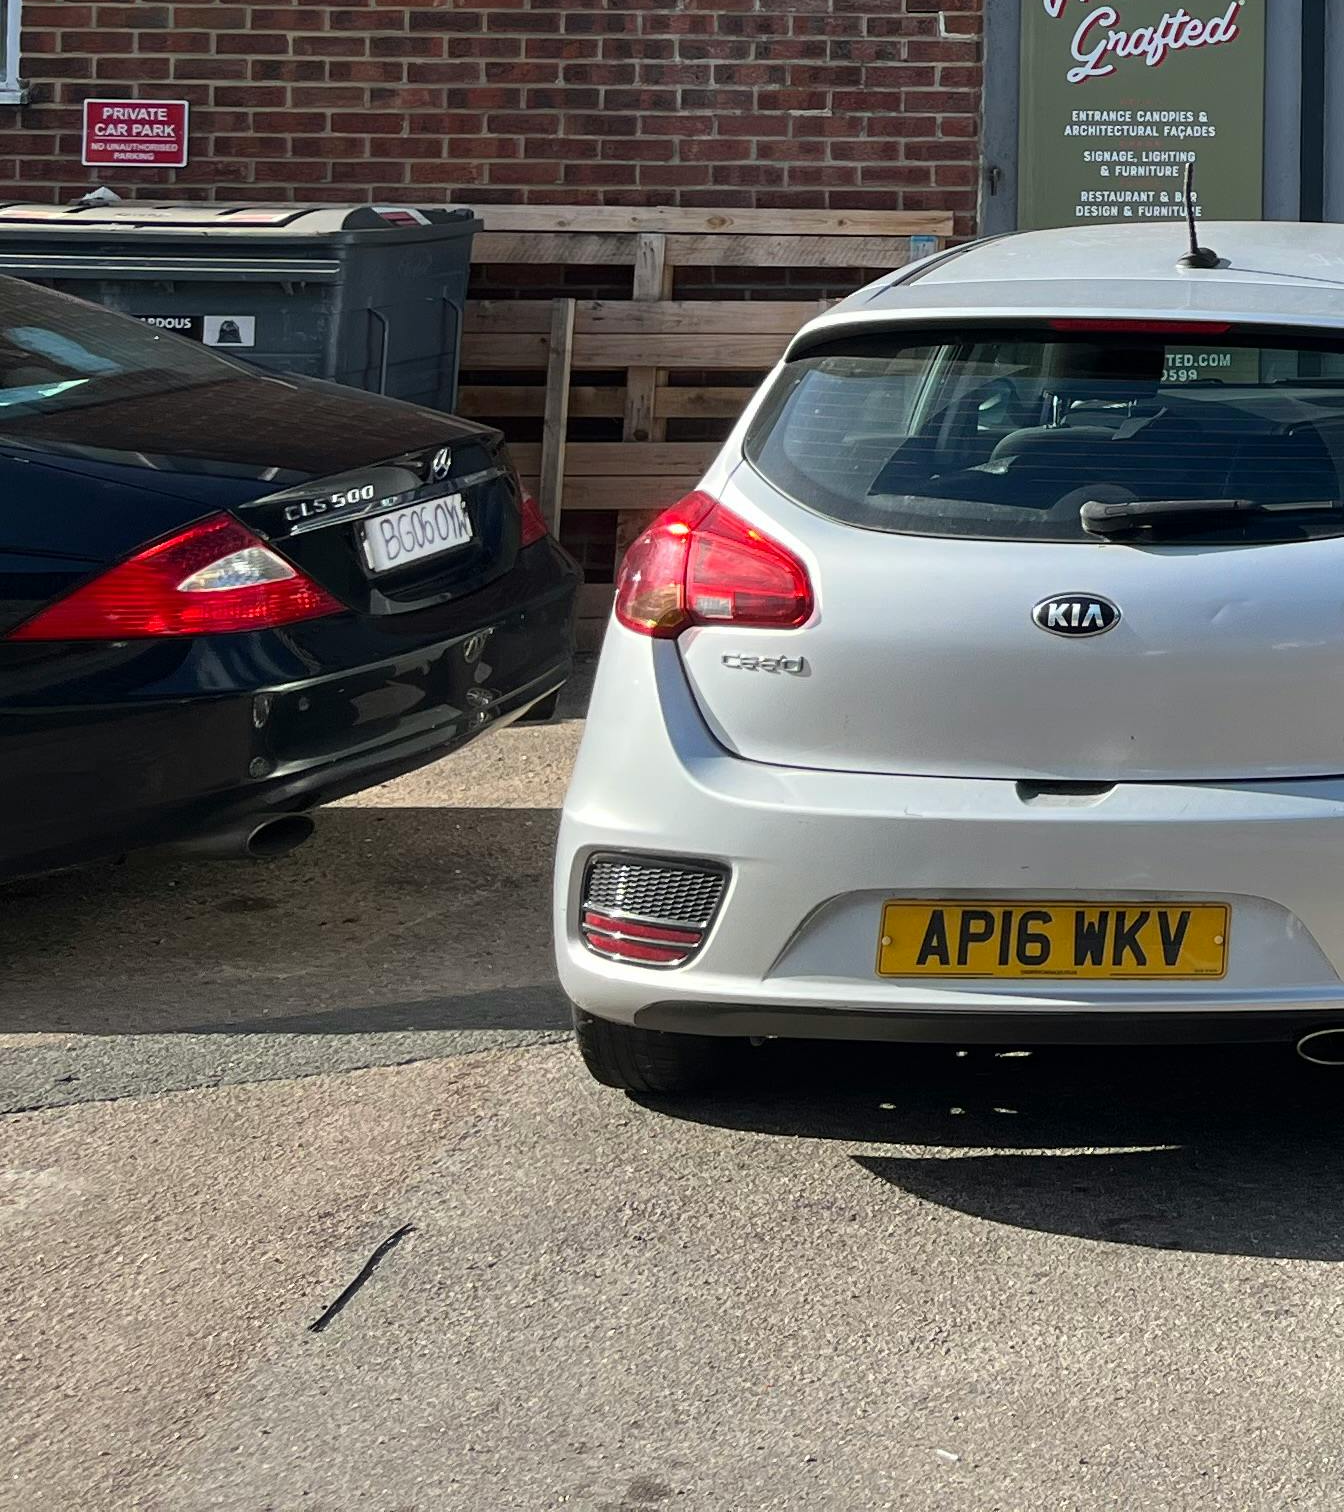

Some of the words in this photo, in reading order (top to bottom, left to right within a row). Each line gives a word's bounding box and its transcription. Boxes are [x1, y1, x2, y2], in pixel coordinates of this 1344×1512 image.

[1066, 1, 1241, 84] Grafted
[102, 107, 168, 121] PRIVATE
[1072, 110, 1132, 122] ENTRANCE
[1136, 111, 1194, 122] CANOPIES
[1198, 111, 1209, 123] &
[94, 123, 128, 136] CAR
[132, 124, 176, 137] PARK
[1064, 125, 1159, 137] ARCHITECTURAL
[1164, 125, 1217, 139] FAÇADES
[91, 142, 105, 151] NO
[113, 152, 155, 161] PARKING
[1083, 151, 1138, 163] SIGNAGE,
[1142, 151, 1196, 162] LIGHTING
[1100, 165, 1110, 177] &
[1115, 165, 1180, 177] FURNITURE
[1080, 191, 1155, 202] RESTAURANT
[1159, 191, 1170, 203] &
[1075, 206, 1118, 217] DESIGN
[1123, 206, 1133, 217] &
[1138, 206, 1202, 217] FURNITUE
[140, 317, 192, 329] DOUS
[284, 500, 327, 522] CLS
[331, 484, 375, 508] 500
[1047, 602, 1105, 627] KIA
[915, 909, 1054, 966] AP16
[1073, 910, 1191, 967] WKV
